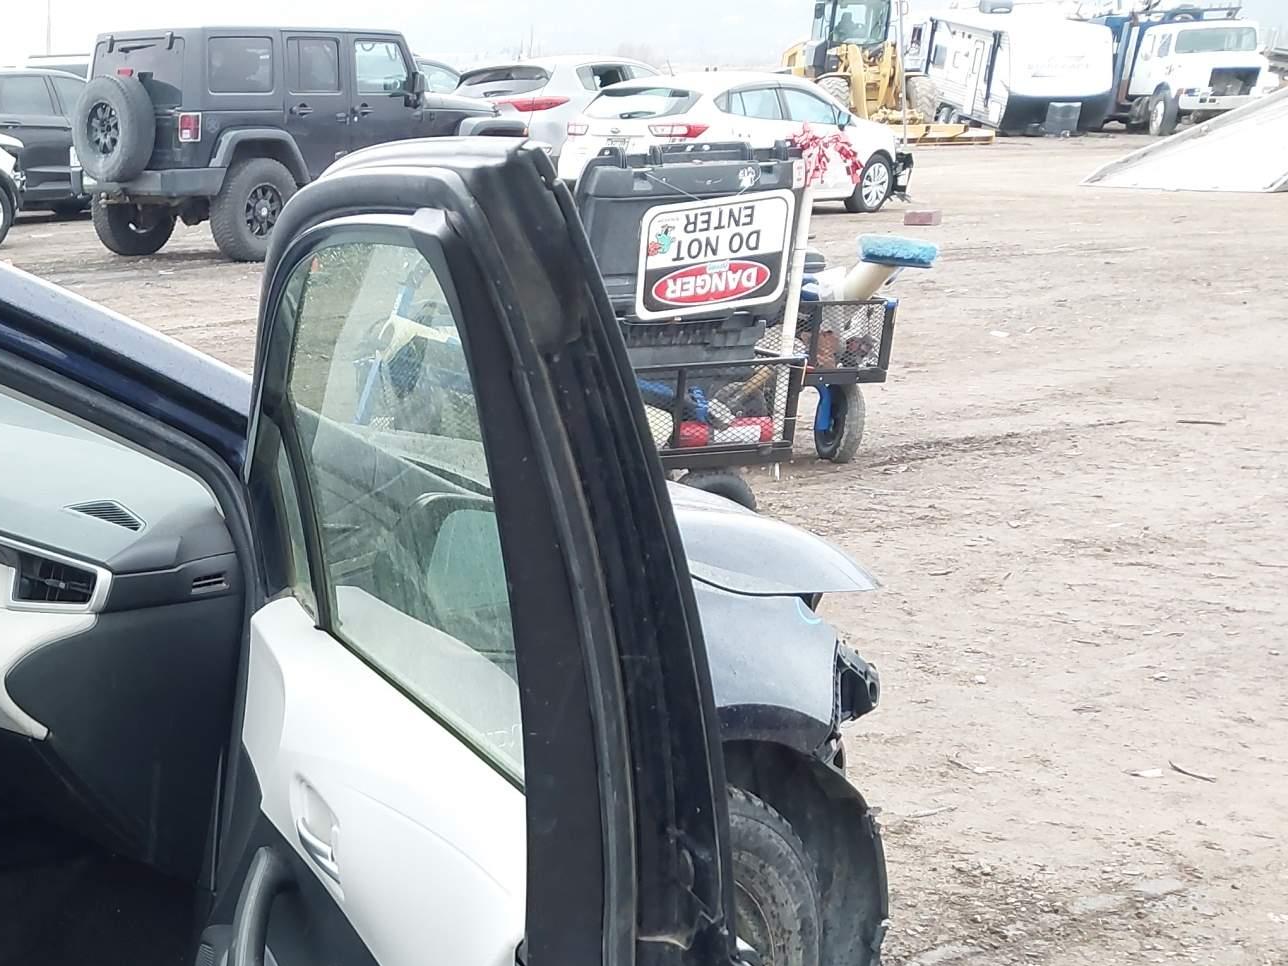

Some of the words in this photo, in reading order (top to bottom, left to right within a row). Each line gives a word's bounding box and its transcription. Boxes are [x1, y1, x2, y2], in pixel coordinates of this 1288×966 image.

[683, 205, 755, 233] ENTER
[672, 235, 720, 262] NOT
[728, 229, 761, 254] DO
[665, 267, 758, 298] DANGER
